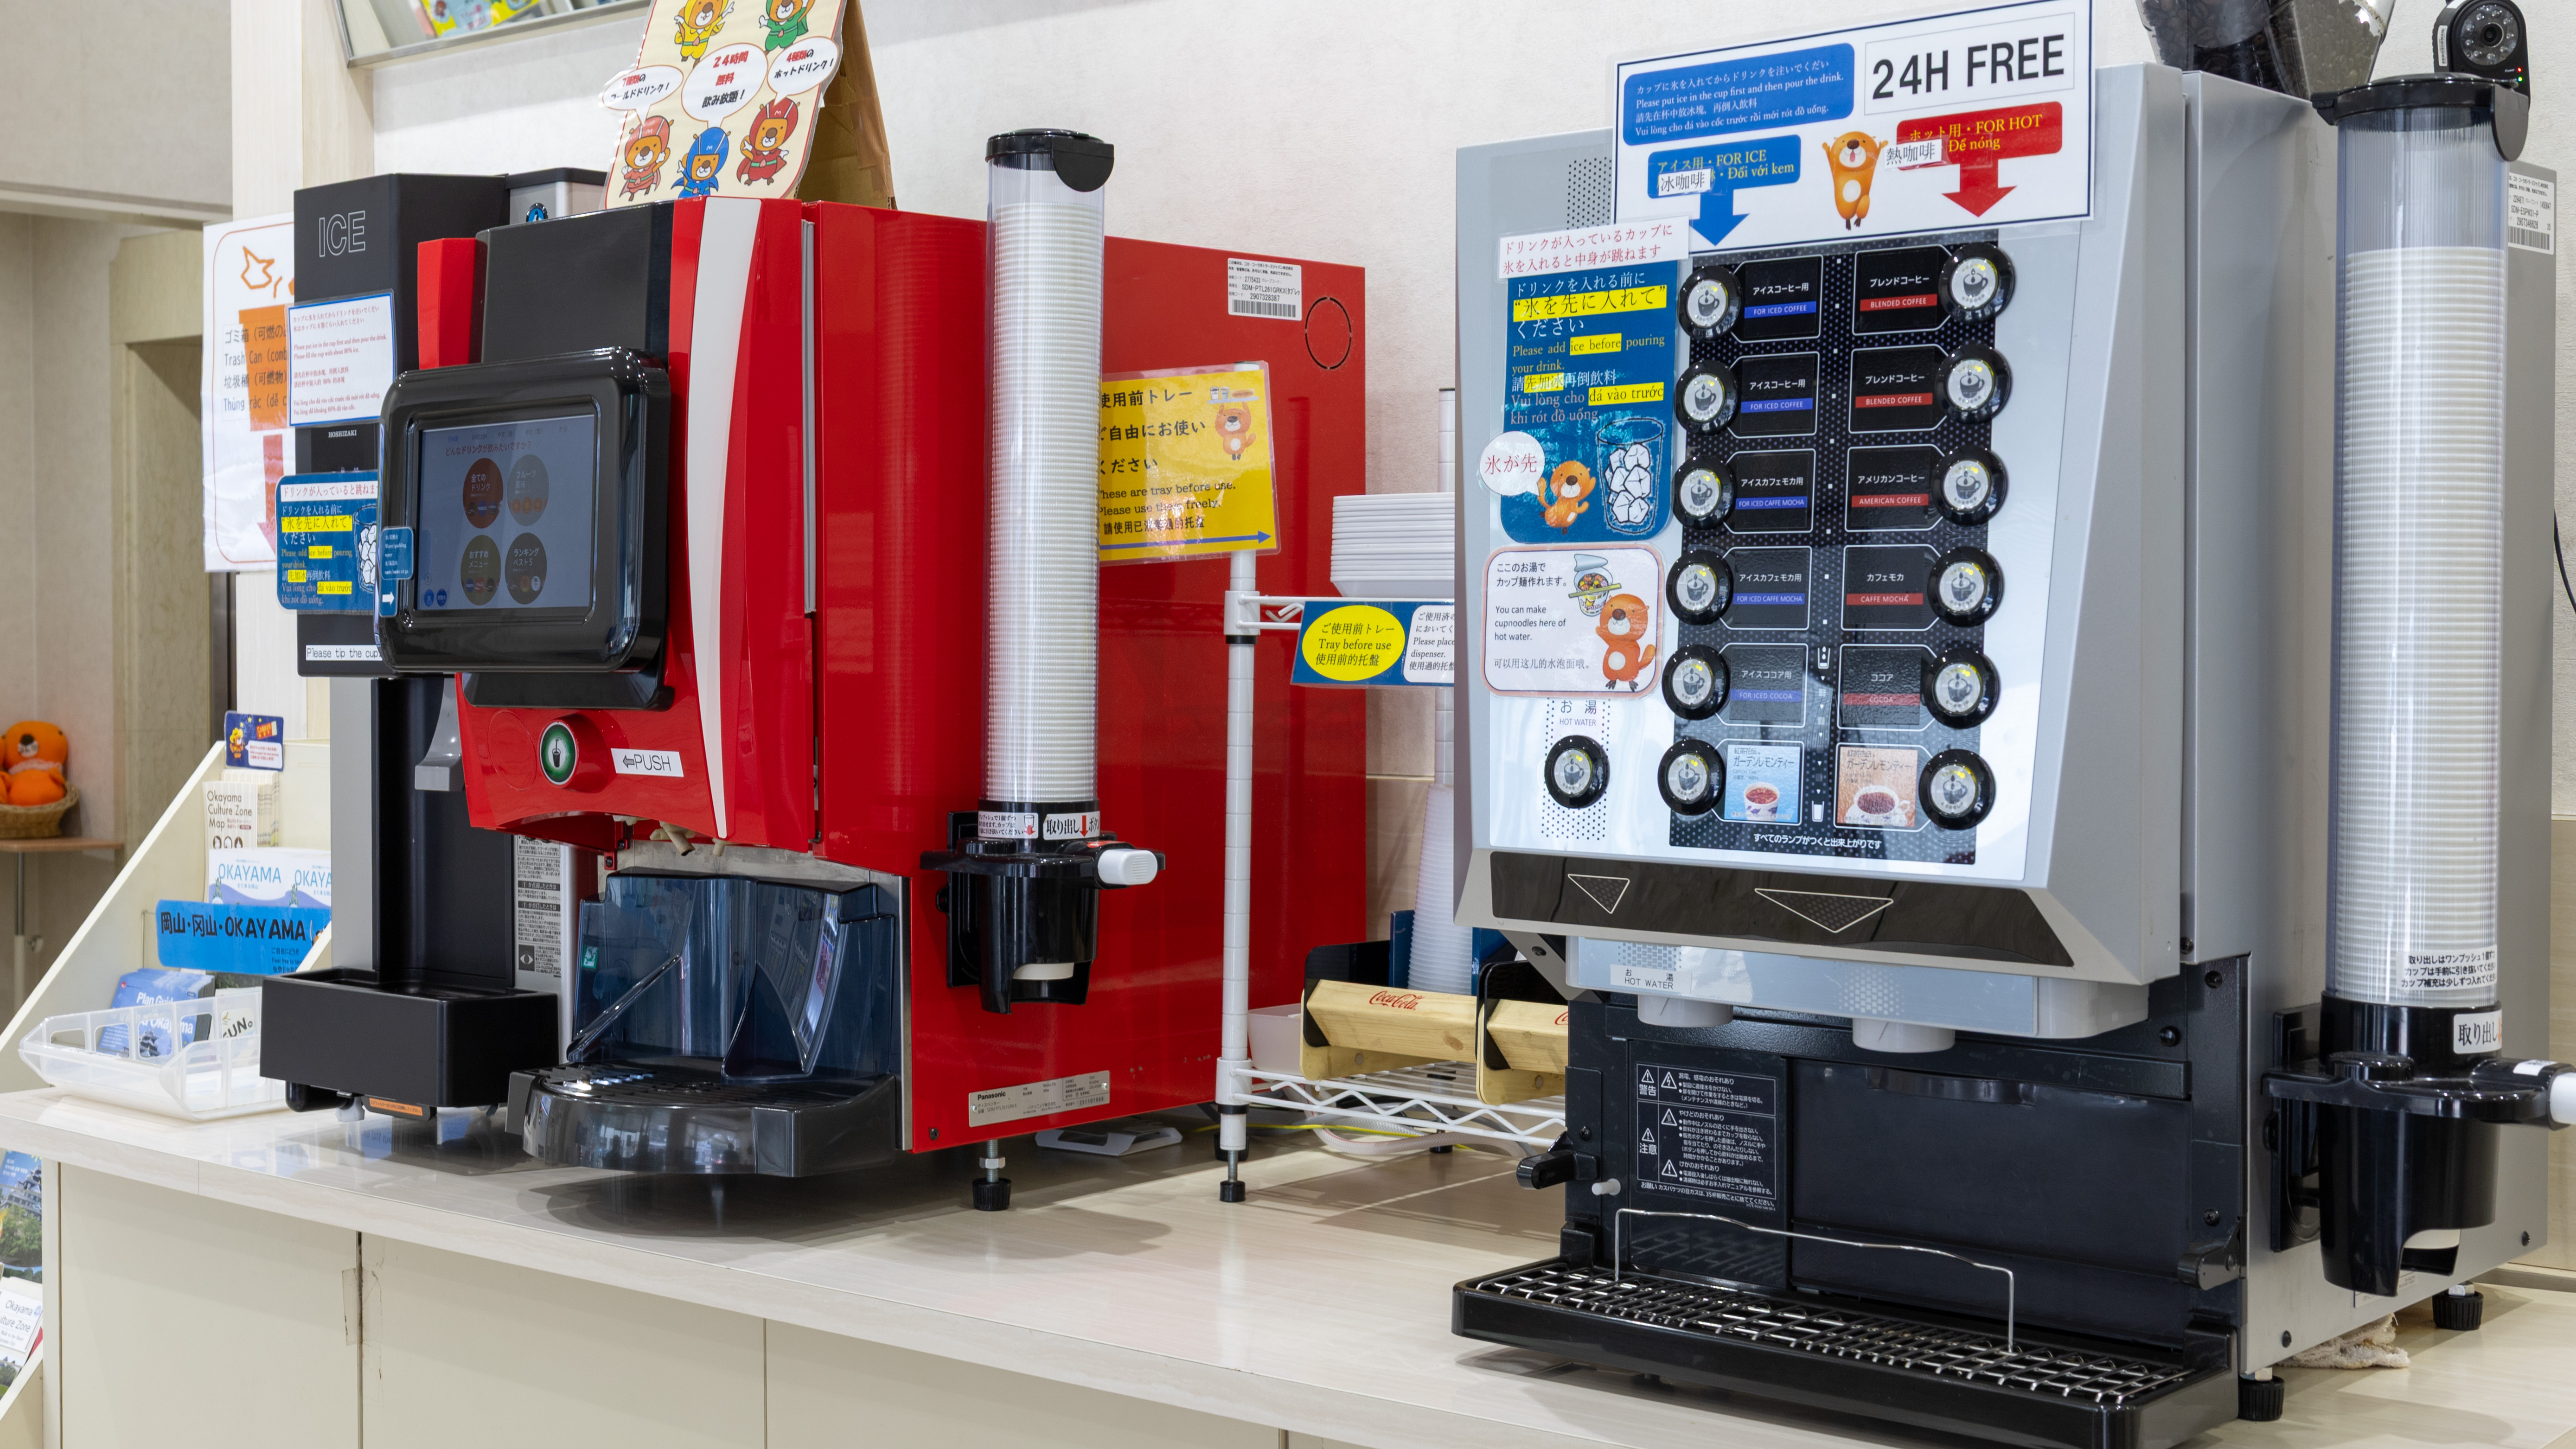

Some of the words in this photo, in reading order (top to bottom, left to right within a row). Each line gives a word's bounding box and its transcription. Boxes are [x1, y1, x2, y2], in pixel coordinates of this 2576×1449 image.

[1873, 50, 1948, 100] 24H
[1967, 34, 2064, 87] FREE
[716, 72, 734, 86] 無料
[1636, 98, 1659, 109] Please
[1662, 96, 1675, 107] put
[1677, 94, 1688, 103] ice
[1690, 93, 1697, 102] in
[1700, 90, 1712, 100] the
[1714, 90, 1728, 100] cup
[1731, 86, 1745, 96] first
[1748, 83, 1762, 94] and
[1765, 81, 1783, 91] then
[1785, 80, 1805, 91] pour
[1806, 76, 1818, 86] the
[1820, 71, 1843, 84] drink.
[1636, 126, 1649, 136] Vui
[1650, 124, 1667, 135] lòng
[1669, 122, 1682, 132] cho
[1685, 119, 1694, 129] đá
[1696, 119, 1709, 128] vào
[1711, 115, 1724, 127] cốc
[1726, 114, 1748, 125] trước
[1750, 110, 1761, 121] rồi
[1764, 108, 1779, 120] mới
[1781, 106, 1792, 117] rót
[1795, 103, 1804, 115] đồ
[1807, 103, 1828, 115] uống.
[1976, 119, 2005, 134] FOR
[2009, 114, 2042, 129] HOT
[1949, 138, 1967, 152] Để
[1970, 136, 2001, 150] nóng
[1717, 153, 1742, 166] FOR
[1745, 149, 1766, 163] ICE
[1886, 142, 1935, 165] 熱咖啡
[1728, 166, 1748, 179] Đối
[1751, 163, 1768, 177] với
[1772, 162, 1794, 174] kem
[1661, 172, 1705, 192] 冰咖啡
[319, 211, 365, 257] ICE
[1506, 224, 1673, 255] ドリンクが入っているカップに
[1503, 244, 1661, 274] 氷を入れると中身が跳ねます
[1518, 272, 1645, 298] ドリンクを入れる前に
[1870, 275, 1929, 287] ブレンドコーヒー
[1753, 283, 1809, 295] アイスコーヒー用
[1785, 305, 1807, 313] COFFEE
[1871, 300, 1900, 308] BLENDED
[1902, 297, 1926, 306] COFFEE
[1517, 318, 1584, 339] ください
[225, 328, 249, 344] ゴミ箱
[1513, 344, 1543, 357] Please
[1548, 341, 1565, 354] add
[1571, 341, 1584, 352] ice
[1590, 337, 1621, 351] before
[1626, 333, 1665, 350] pouring
[224, 351, 244, 366] Trash
[249, 351, 262, 364] Can
[1512, 364, 1534, 377] your
[1537, 359, 1565, 372] drink.
[224, 397, 244, 411] Thùng
[250, 396, 261, 409] rác
[328, 429, 357, 438] HOSHIZAKI
[1484, 453, 1537, 476] 氷が先
[1741, 478, 1803, 487] アイスカフェモカ用
[1858, 474, 1925, 484] アメリカンコーヒー
[471, 483, 490, 491] ドリンク
[1131, 488, 1147, 497] are
[1151, 485, 1172, 495] tray
[1176, 482, 1211, 493] before
[1214, 481, 1236, 491] use.
[1134, 504, 1152, 513] use
[1186, 498, 1221, 509] freely.
[284, 532, 315, 545] ください
[1497, 562, 1546, 573] ここのお湯で
[1867, 574, 1904, 582] カフェモカ
[1496, 606, 1509, 614] You
[1526, 605, 1547, 613] make
[1322, 623, 1394, 635] ご使用前トレー
[1495, 619, 1537, 629] cupnoodles
[1539, 618, 1556, 627] here
[1558, 618, 1566, 627] of
[1437, 637, 1454, 647] place
[1495, 632, 1506, 640] hot
[1319, 638, 1341, 651] Tray
[1343, 639, 1372, 649] before
[307, 647, 332, 658] Please
[336, 647, 345, 658] tip
[349, 647, 361, 657] the
[1411, 649, 1445, 659] dispenser.
[1316, 654, 1380, 666] 使用前的托盤
[1742, 671, 1791, 680] アイスココア用
[1574, 718, 1596, 727] WATER
[633, 754, 671, 771] PUSH
[1733, 756, 1795, 768] ガーデンレモンティー
[207, 790, 242, 805] Okayama
[208, 803, 232, 815] Culture
[235, 805, 252, 816] Zone
[209, 817, 224, 831] Map
[1046, 818, 1080, 835] 取り出し
[1754, 833, 1881, 849] すべてのランプがつくと出来上がりです
[218, 863, 281, 883] OKAYAMA
[1625, 977, 1641, 985] HOT
[1646, 979, 1673, 989] WATER
[136, 992, 153, 1005] Plan
[2459, 1021, 2497, 1046] 取り出し
[978, 1091, 1006, 1100] Panasonic
[1639, 1085, 1656, 1096] 警告
[1640, 1143, 1657, 1155] 注意
[6, 1300, 33, 1315] Okayama
[15, 1320, 31, 1332] Zone
